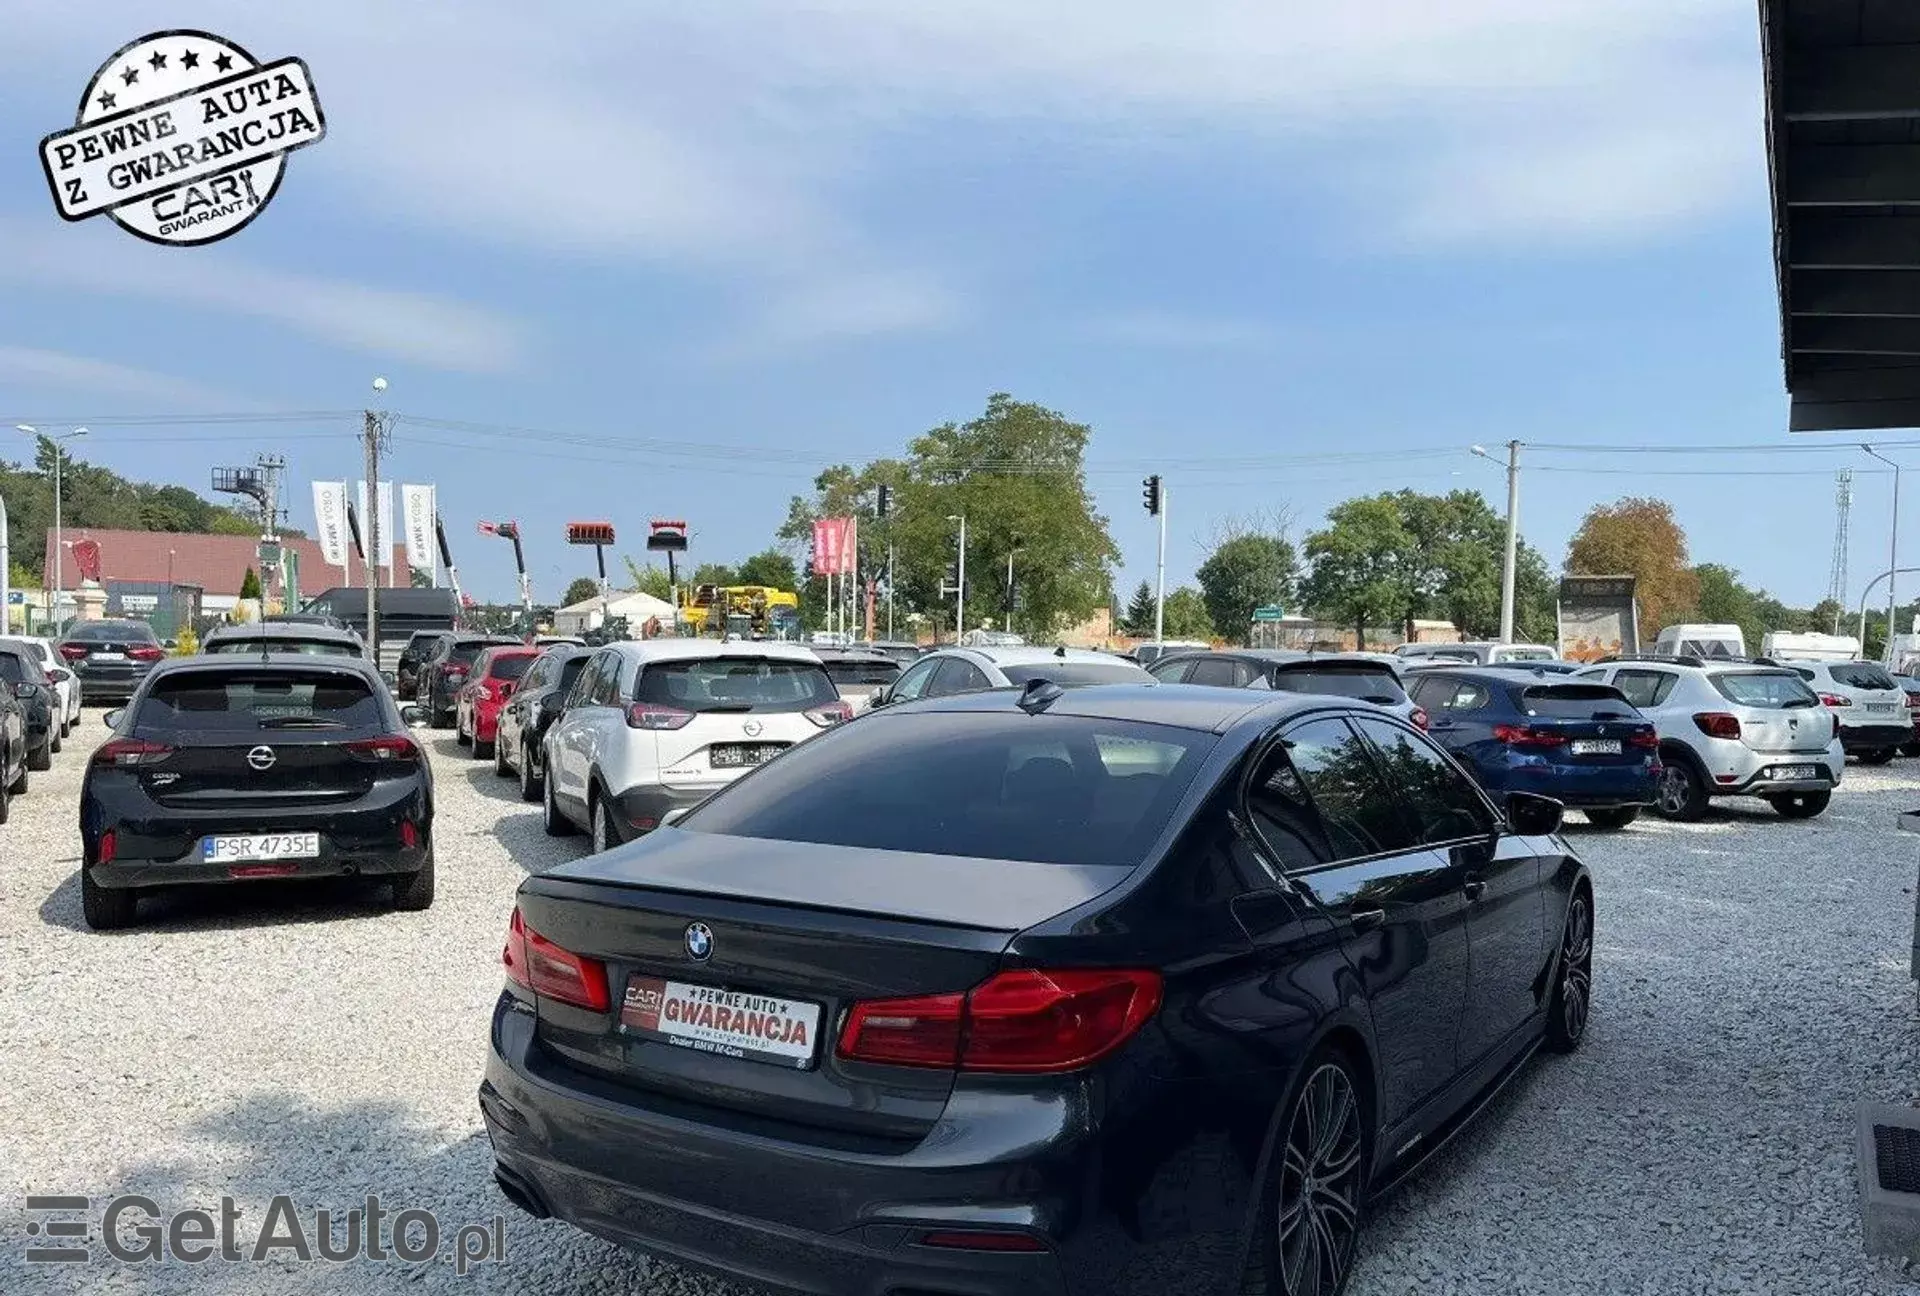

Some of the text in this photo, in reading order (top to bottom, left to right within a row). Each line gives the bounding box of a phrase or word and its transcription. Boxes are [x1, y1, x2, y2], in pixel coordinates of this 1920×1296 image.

[216, 835, 316, 856] PSR 4735E
[699, 988, 777, 1013] PEWNE AUTO
[663, 997, 808, 1046] GWARANCJA
[694, 1040, 715, 1052] BMW
